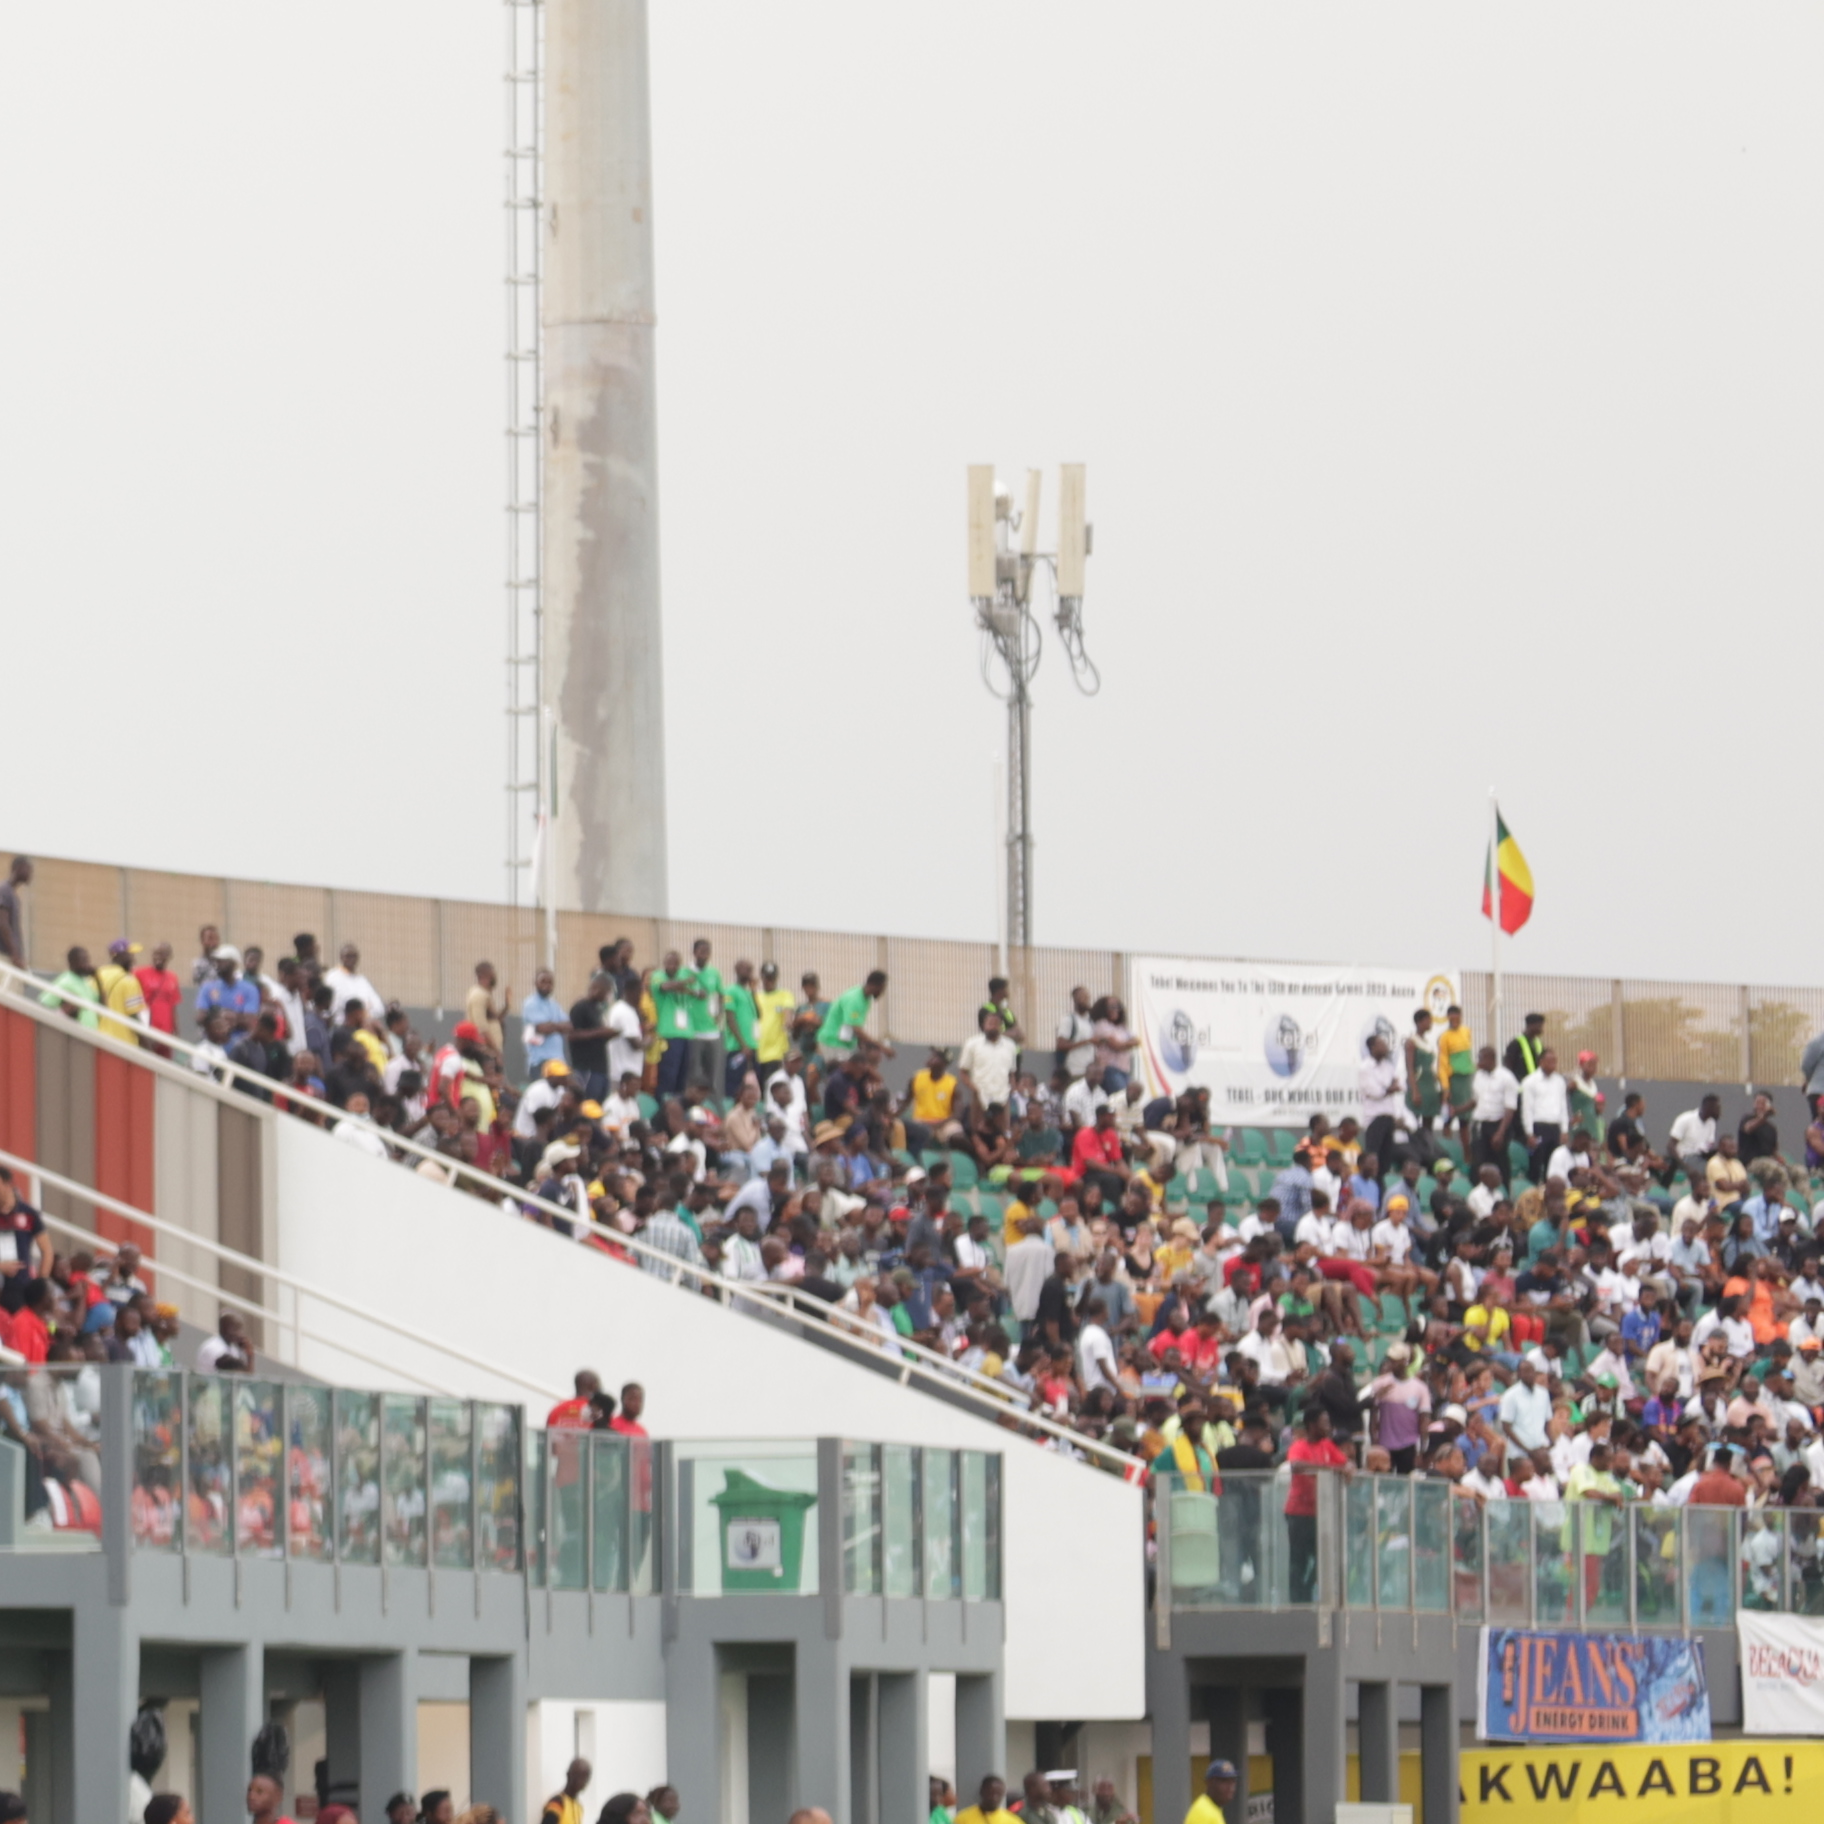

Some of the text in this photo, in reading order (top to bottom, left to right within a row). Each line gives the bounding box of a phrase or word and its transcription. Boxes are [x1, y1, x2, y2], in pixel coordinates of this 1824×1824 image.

[1509, 1637, 1637, 1735] JEANS
[1535, 1709, 1628, 1731] ENERGY DRINK
